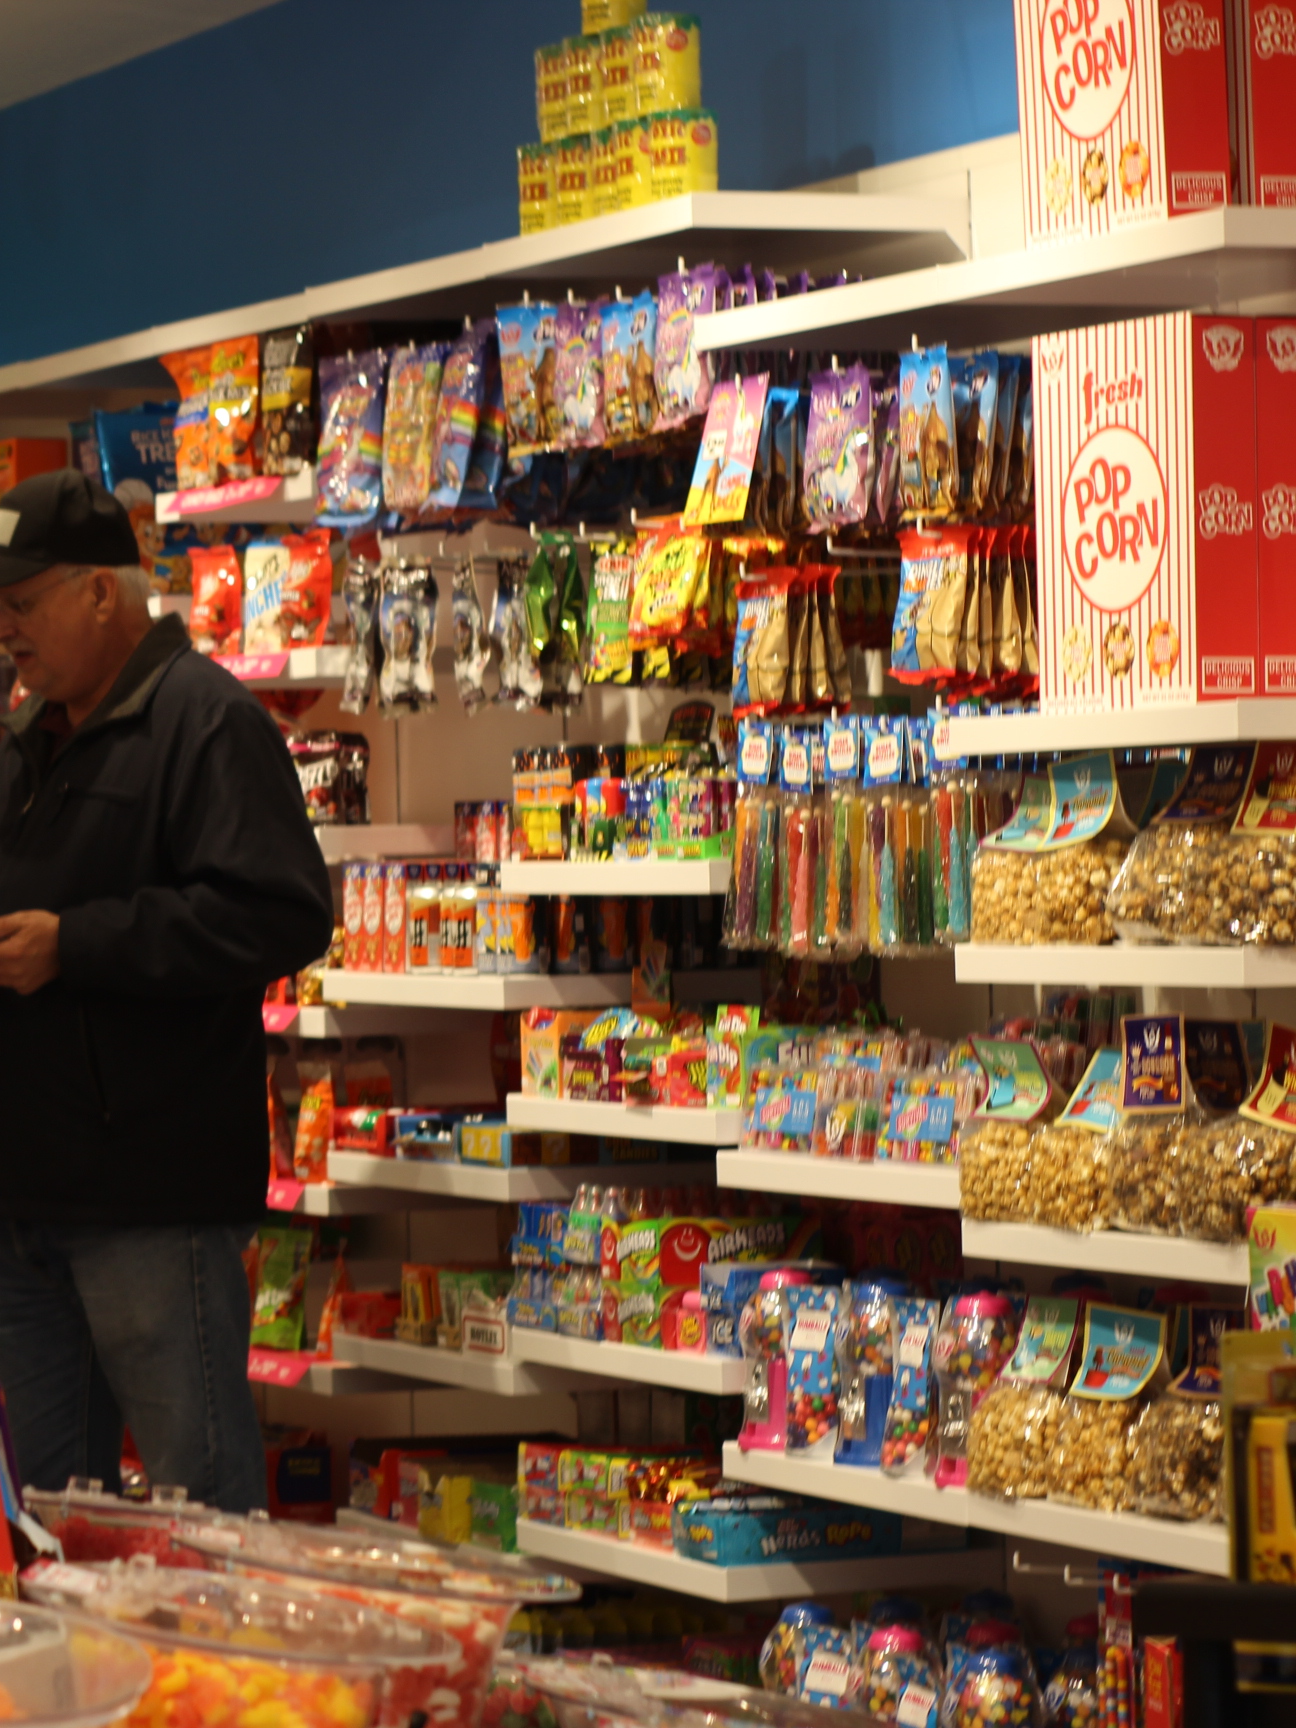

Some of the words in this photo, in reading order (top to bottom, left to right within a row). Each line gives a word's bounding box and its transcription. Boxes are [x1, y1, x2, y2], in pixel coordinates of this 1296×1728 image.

[1050, 0, 1099, 56] POP
[1054, 18, 1127, 111] CORN
[1174, 176, 1223, 190] DELICIOUS
[1188, 192, 1215, 206] CRISP
[1264, 180, 1296, 195] DELICI
[1083, 368, 1143, 425] fresh
[1073, 457, 1132, 524] POP
[1074, 497, 1159, 581] CORN
[1206, 660, 1251, 676] DELICIOUS
[1216, 675, 1243, 688] CRISP
[707, 1222, 786, 1263] AIRHEADS
